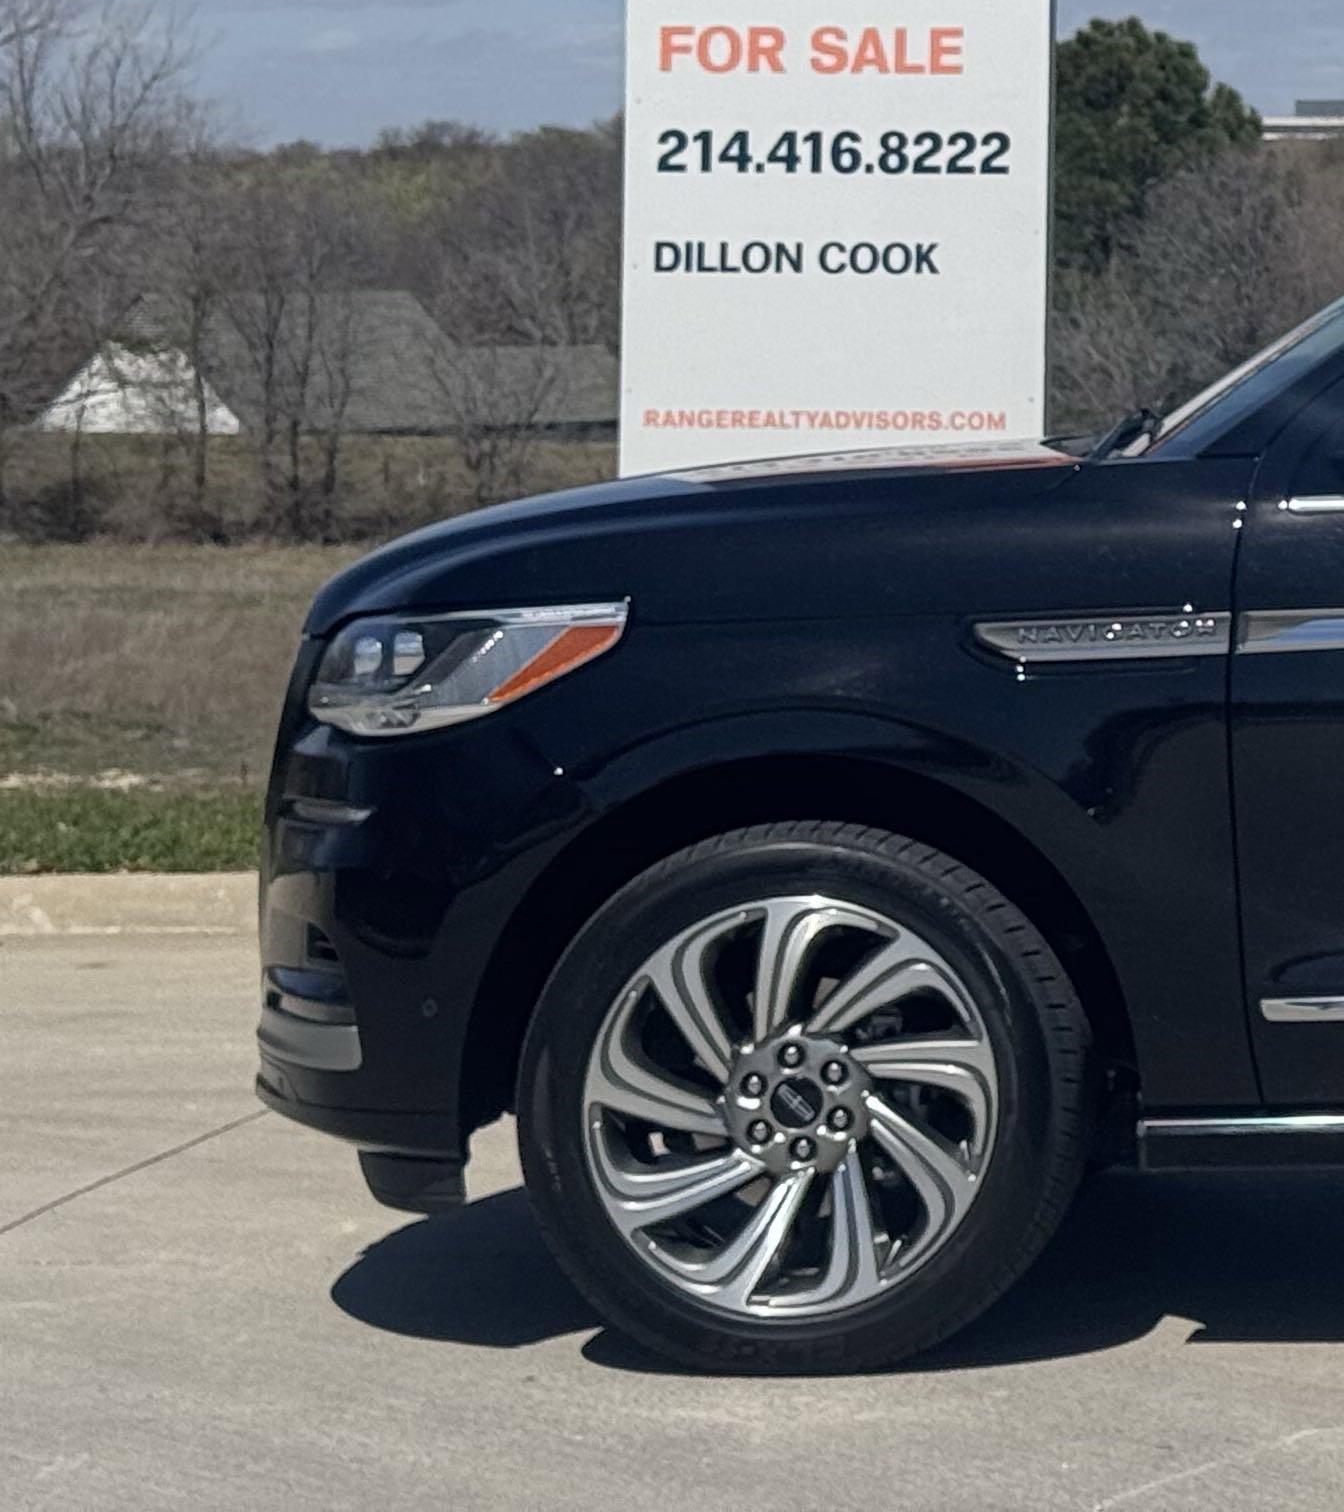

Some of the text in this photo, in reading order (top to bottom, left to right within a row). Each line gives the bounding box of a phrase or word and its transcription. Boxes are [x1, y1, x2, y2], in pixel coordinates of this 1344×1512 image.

[657, 25, 965, 75] FOR SALE
[656, 128, 1012, 175] 214.416.8222
[653, 240, 941, 275] DILLON COOK
[642, 408, 1007, 431] RANGEREALTYADVISORS.COM
